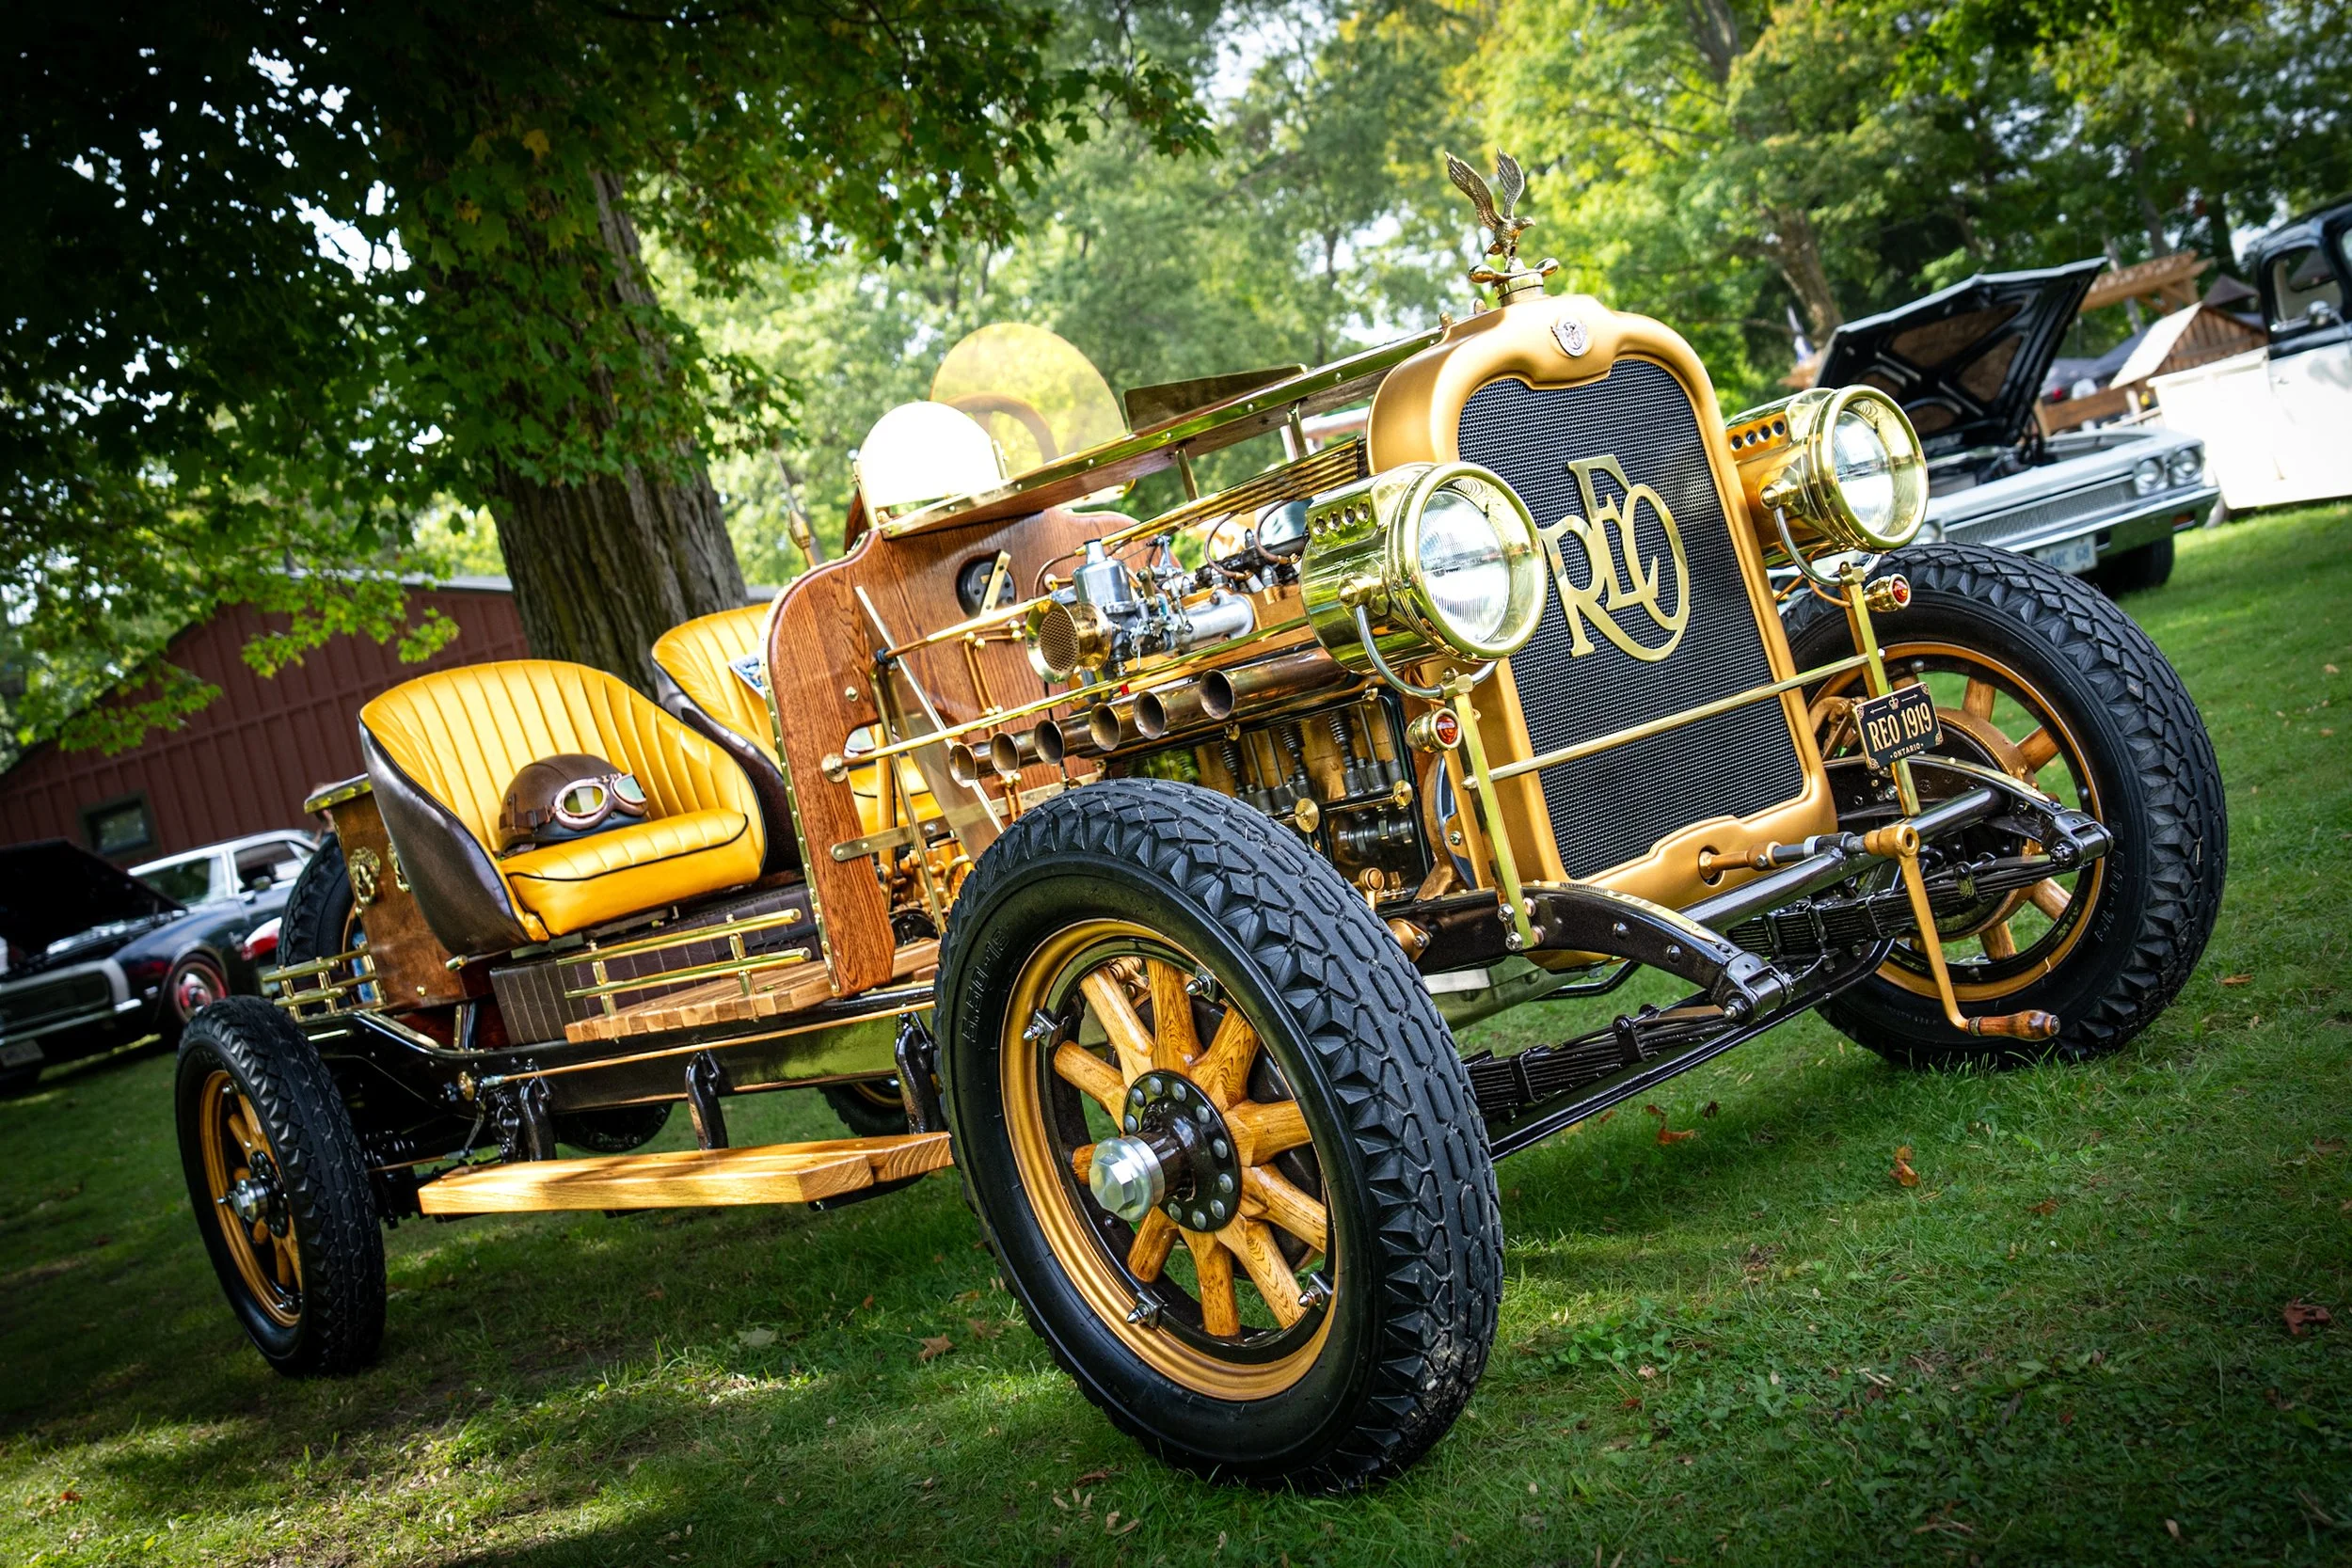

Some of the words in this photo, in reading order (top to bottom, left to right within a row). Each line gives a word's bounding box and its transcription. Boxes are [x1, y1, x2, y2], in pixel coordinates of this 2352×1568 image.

[1538, 454, 1690, 662] REO
[1867, 714, 1900, 752] REO
[1900, 702, 1932, 740] 1919
[1893, 743, 1920, 759] ONTARIO
